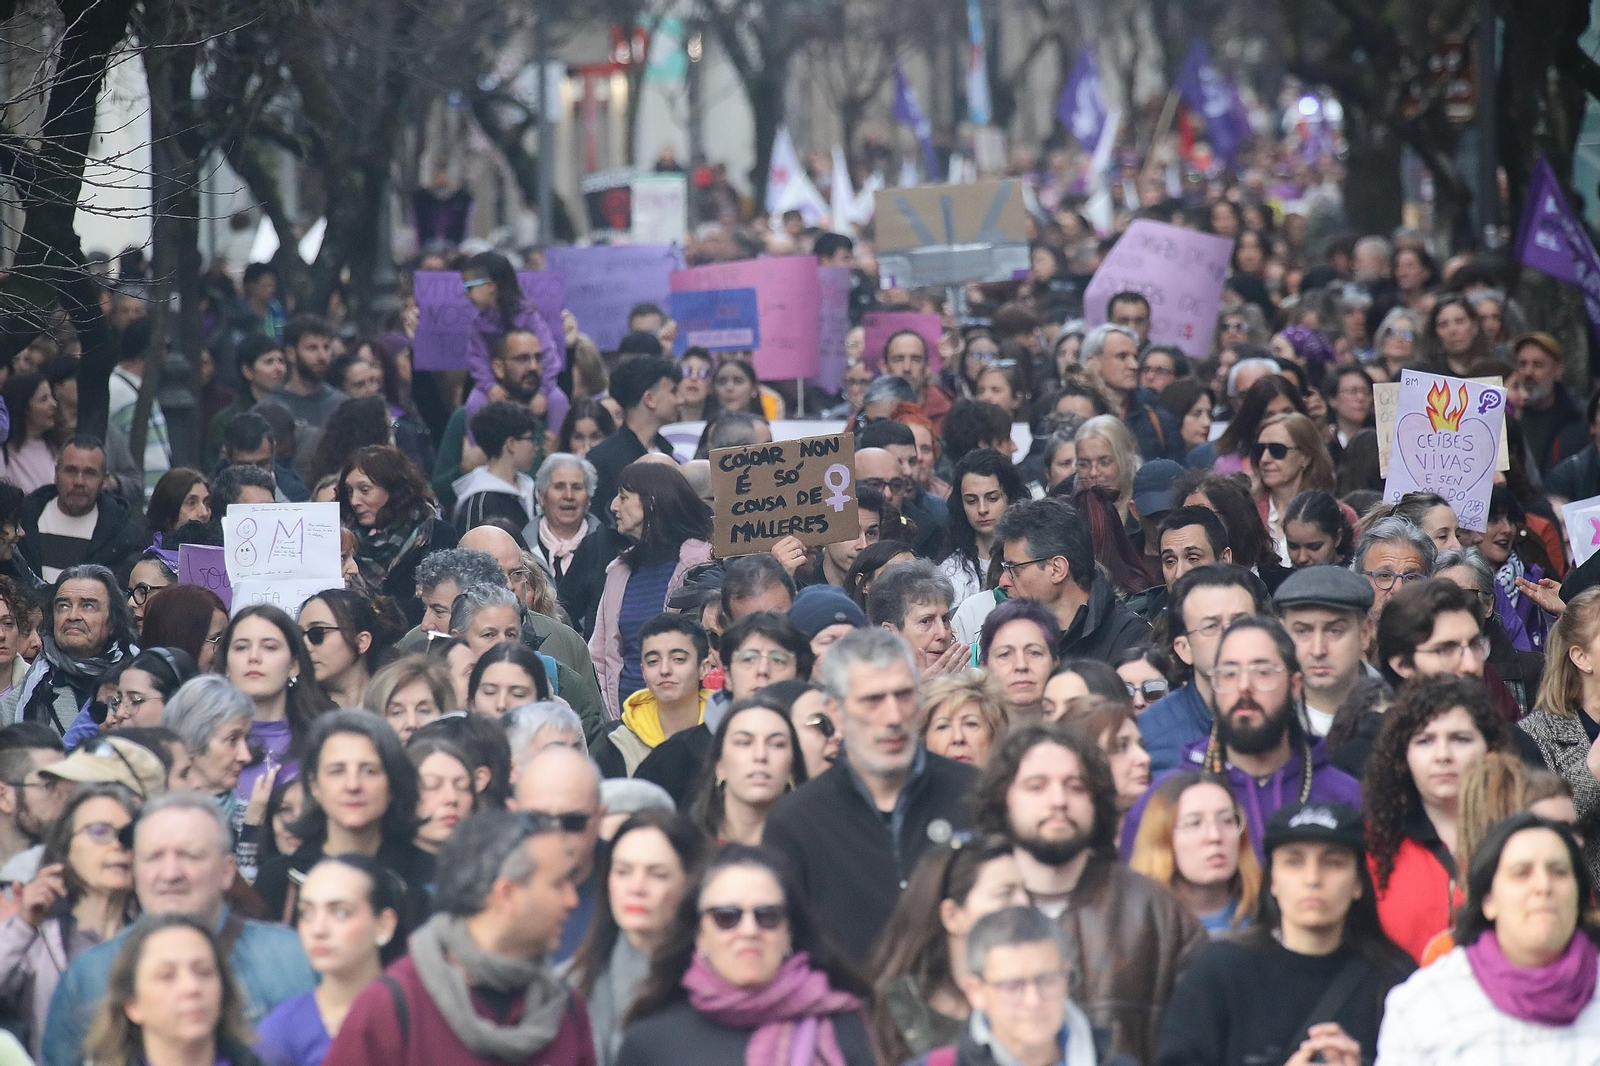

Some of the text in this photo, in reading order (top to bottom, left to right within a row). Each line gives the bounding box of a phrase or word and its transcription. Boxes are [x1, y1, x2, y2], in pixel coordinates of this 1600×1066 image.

[1405, 377, 1419, 387] 8M
[800, 436, 840, 458] NON
[735, 460, 804, 495] É SÓ
[1425, 473, 1464, 486] E SEN
[731, 486, 823, 516] COUSA DE
[730, 514, 830, 544] MULLERES
[251, 586, 281, 604] DÍA
